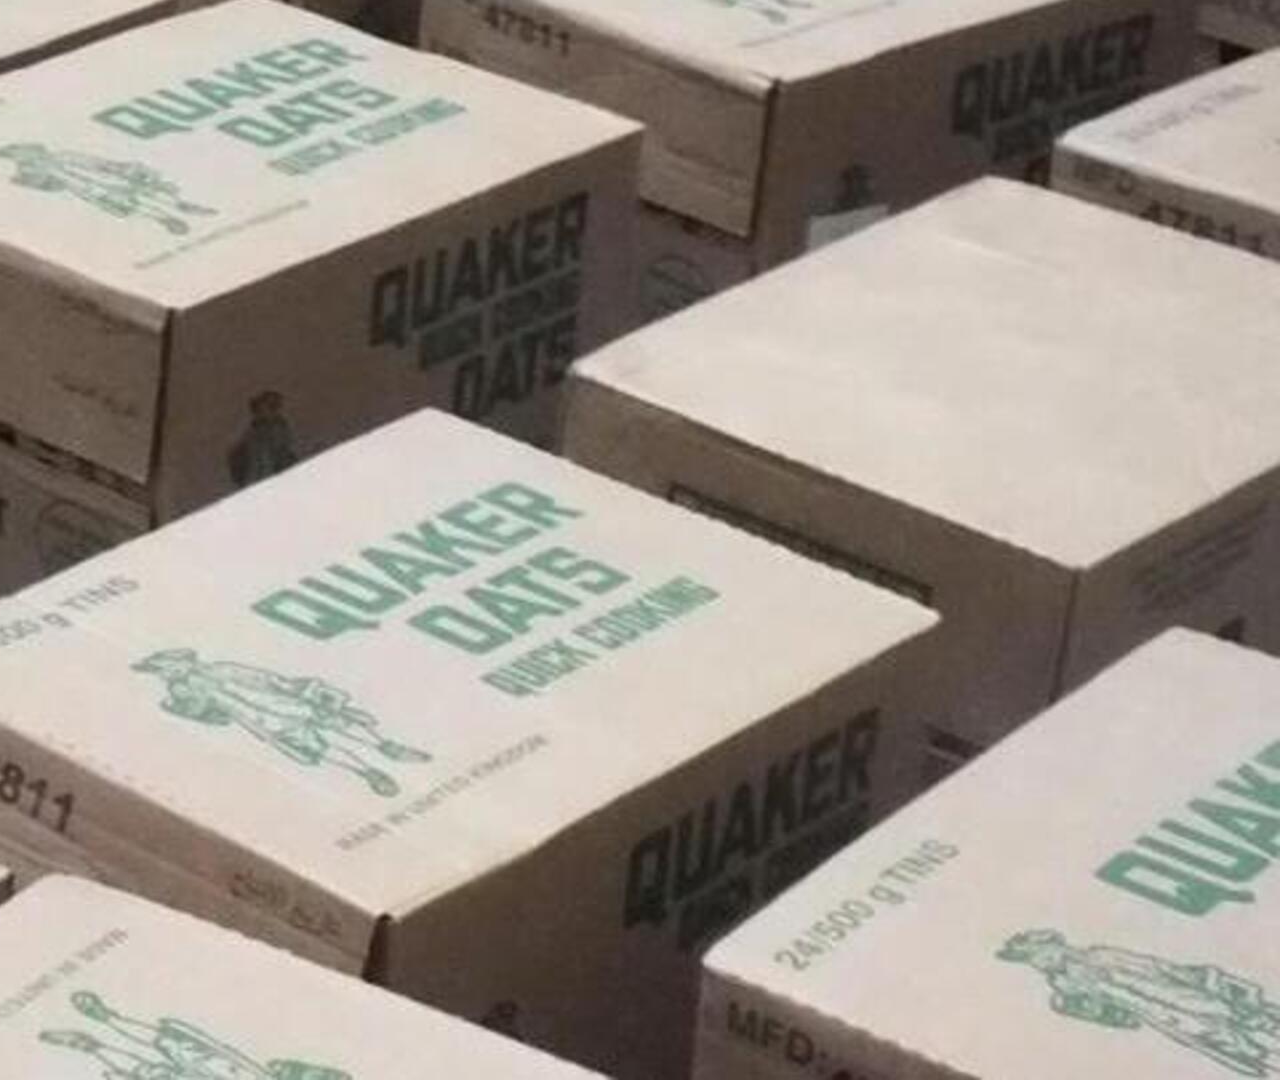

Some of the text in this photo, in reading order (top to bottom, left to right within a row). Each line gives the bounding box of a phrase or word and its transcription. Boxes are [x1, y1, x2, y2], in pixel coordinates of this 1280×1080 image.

[90, 37, 370, 141] QUAKER
[214, 77, 401, 149] OATS
[369, 191, 591, 349] QUAKER
[250, 480, 587, 641] QUAKER
[407, 545, 633, 655] OATS
[481, 636, 603, 697] QUICK
[624, 705, 881, 930] QUAKER
[1093, 739, 1280, 918] QUAK
[773, 837, 960, 972] 24/500 g TINS
[725, 1000, 831, 1069] MFD:
